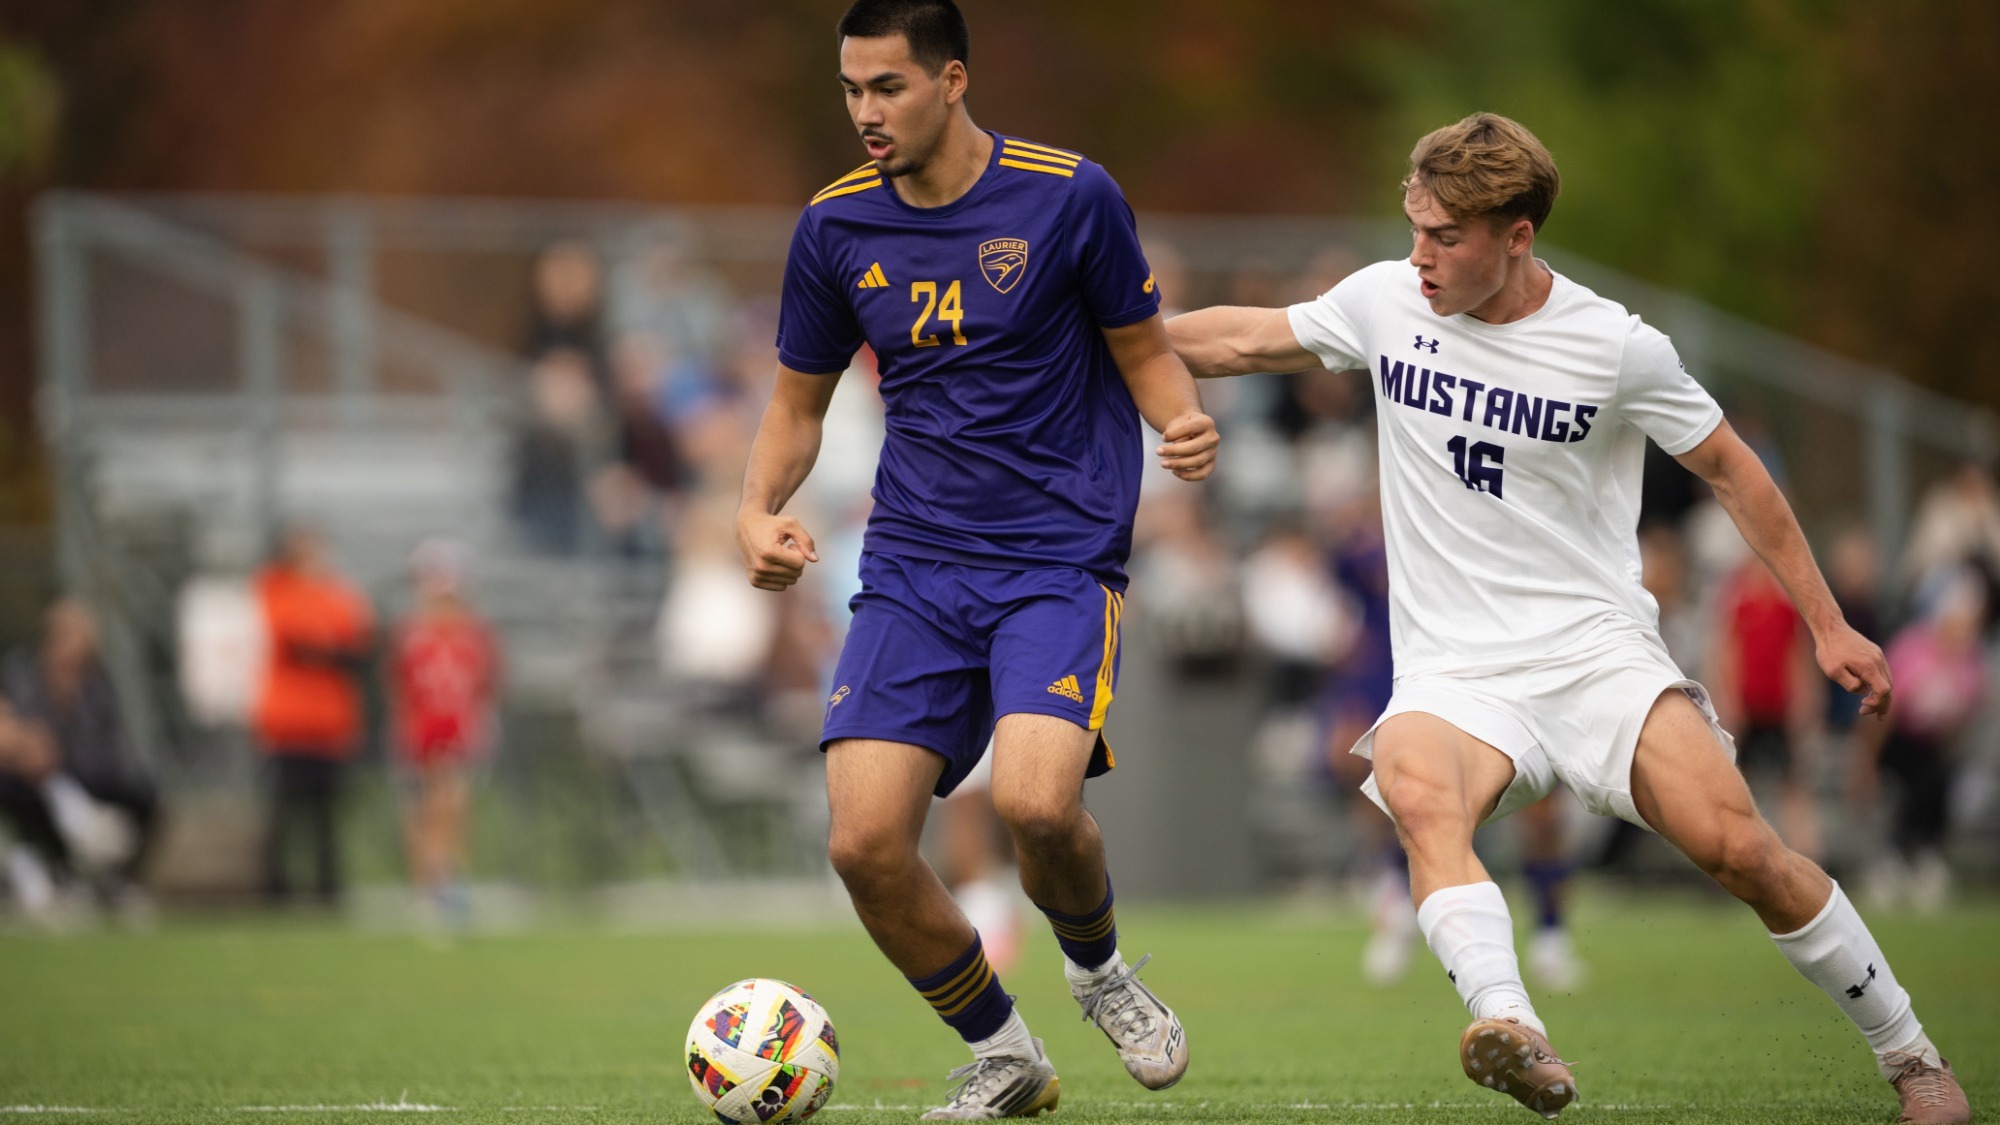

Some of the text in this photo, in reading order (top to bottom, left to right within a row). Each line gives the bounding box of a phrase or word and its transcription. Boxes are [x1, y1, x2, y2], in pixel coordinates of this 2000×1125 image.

[982, 241, 1025, 253] LAURIER
[911, 280, 967, 347] 24
[1380, 354, 1598, 443] MUSTANGS
[1447, 435, 1504, 500] 16
[1047, 685, 1083, 703] adidas
